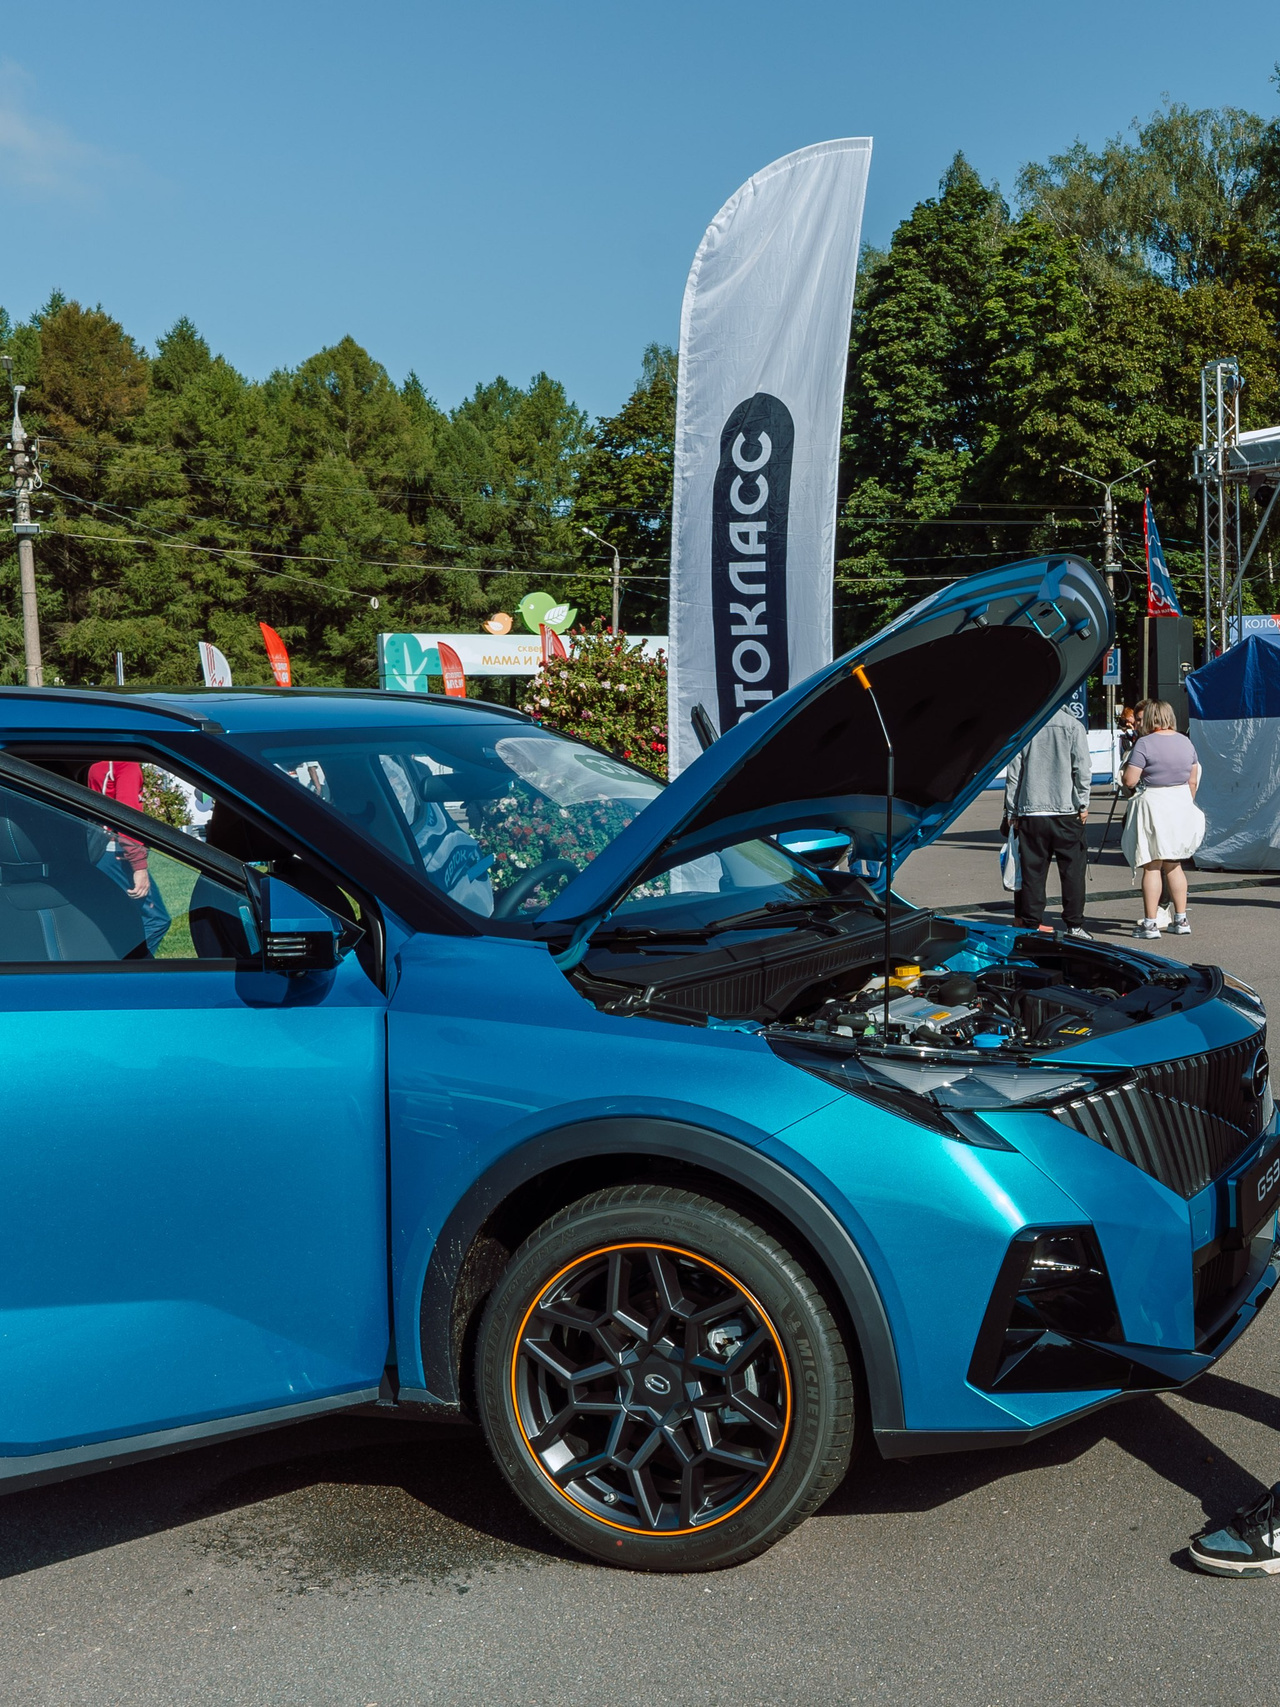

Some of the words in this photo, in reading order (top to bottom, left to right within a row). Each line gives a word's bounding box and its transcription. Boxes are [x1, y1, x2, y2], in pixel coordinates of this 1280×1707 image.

[728, 431, 773, 725] ТОКЛАСС
[481, 655, 520, 665] МАМА
[524, 656, 532, 665] И
[1258, 1158, 1280, 1202] GS3
[796, 1338, 820, 1458] MICHELIN
